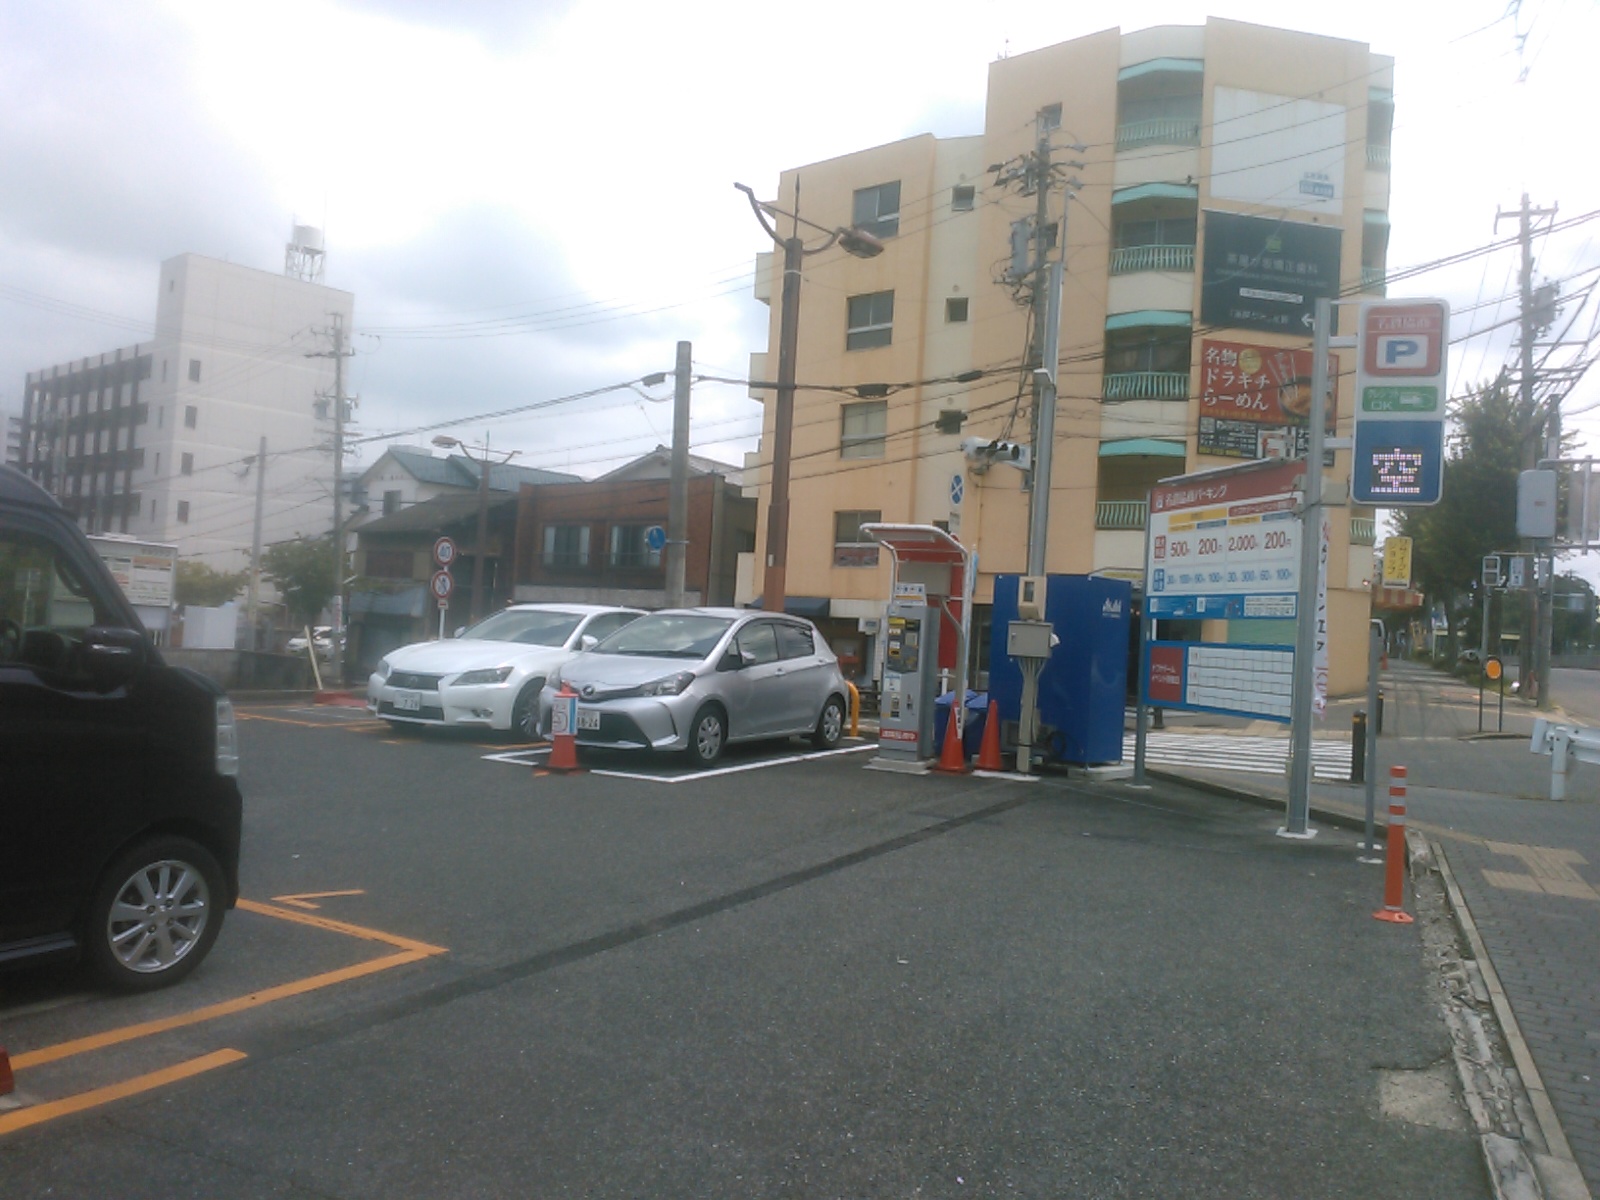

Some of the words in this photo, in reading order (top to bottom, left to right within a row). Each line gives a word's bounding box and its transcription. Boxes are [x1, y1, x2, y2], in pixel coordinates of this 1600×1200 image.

[1205, 346, 1238, 367] 名物
[1385, 340, 1419, 364] P
[1207, 368, 1271, 390] ドラキチ
[1203, 387, 1269, 411] らーめん
[1371, 448, 1422, 494] 空
